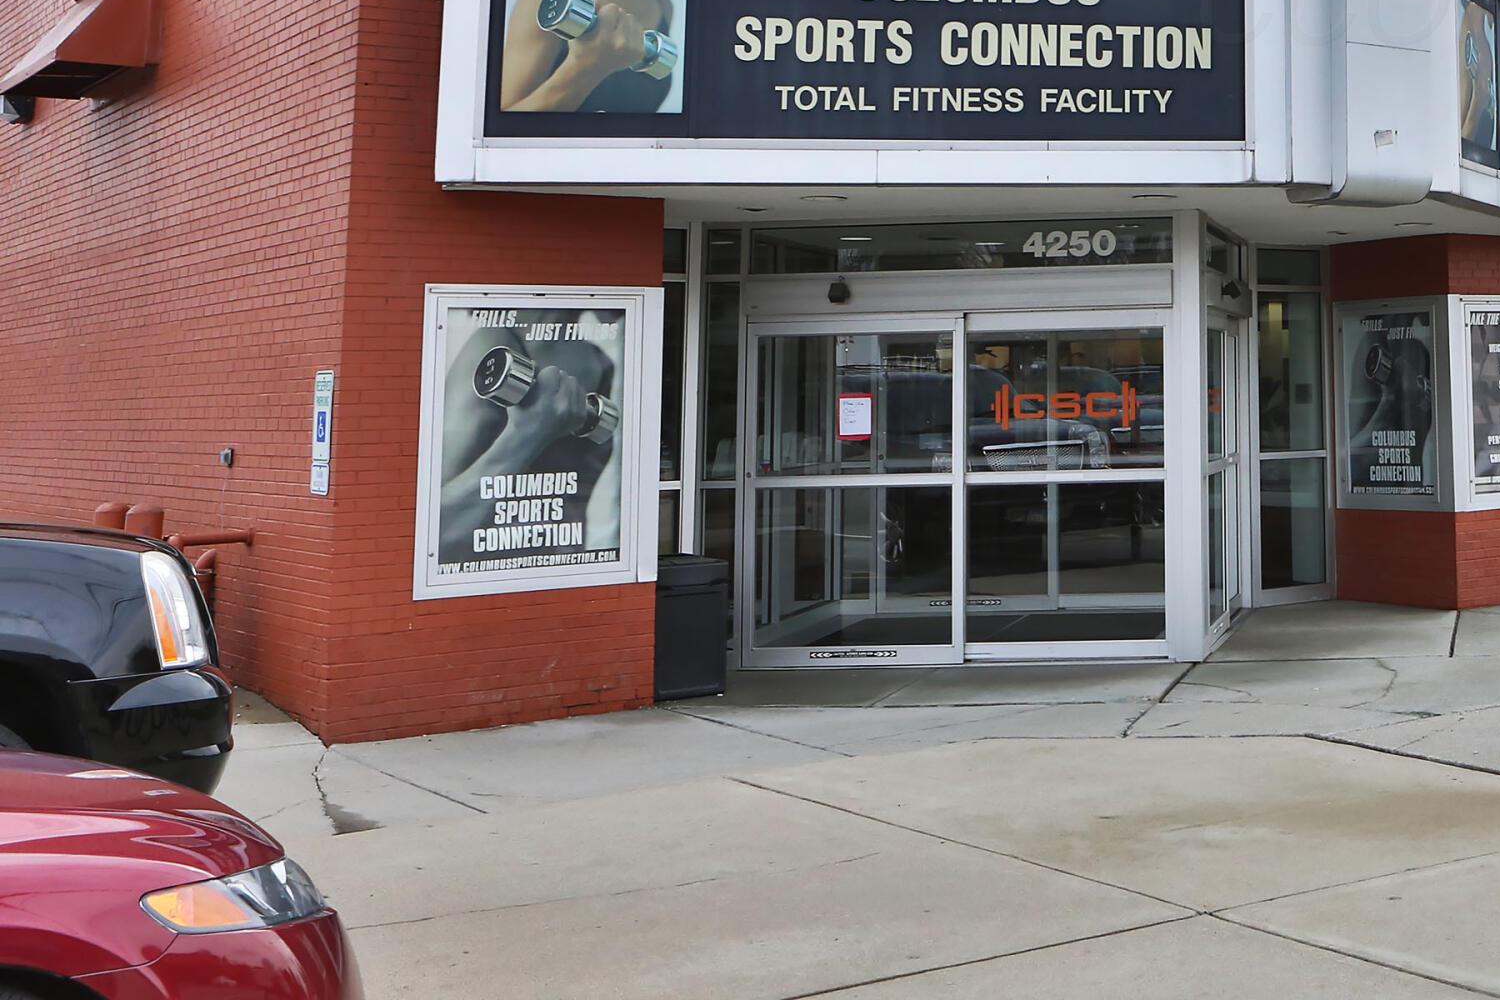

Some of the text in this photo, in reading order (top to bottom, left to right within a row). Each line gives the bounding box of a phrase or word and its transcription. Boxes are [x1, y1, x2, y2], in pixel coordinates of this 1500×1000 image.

[734, 15, 1212, 70] SPORTS CONNECTION
[774, 85, 1174, 114] TOTAL FITNESS FACILITY
[1022, 229, 1117, 258] 4250
[525, 323, 563, 341] JUST
[1470, 312, 1485, 326] AKE
[1486, 312, 1500, 326] THE
[1013, 391, 1118, 421] CSC
[1371, 430, 1416, 447] COLUMBUS
[1378, 448, 1411, 464] SPORTS
[480, 471, 578, 500] COLUMBUS
[1369, 465, 1422, 482] CONNECTION
[494, 497, 564, 525] SPORTS
[473, 522, 583, 552] CONNECTION
